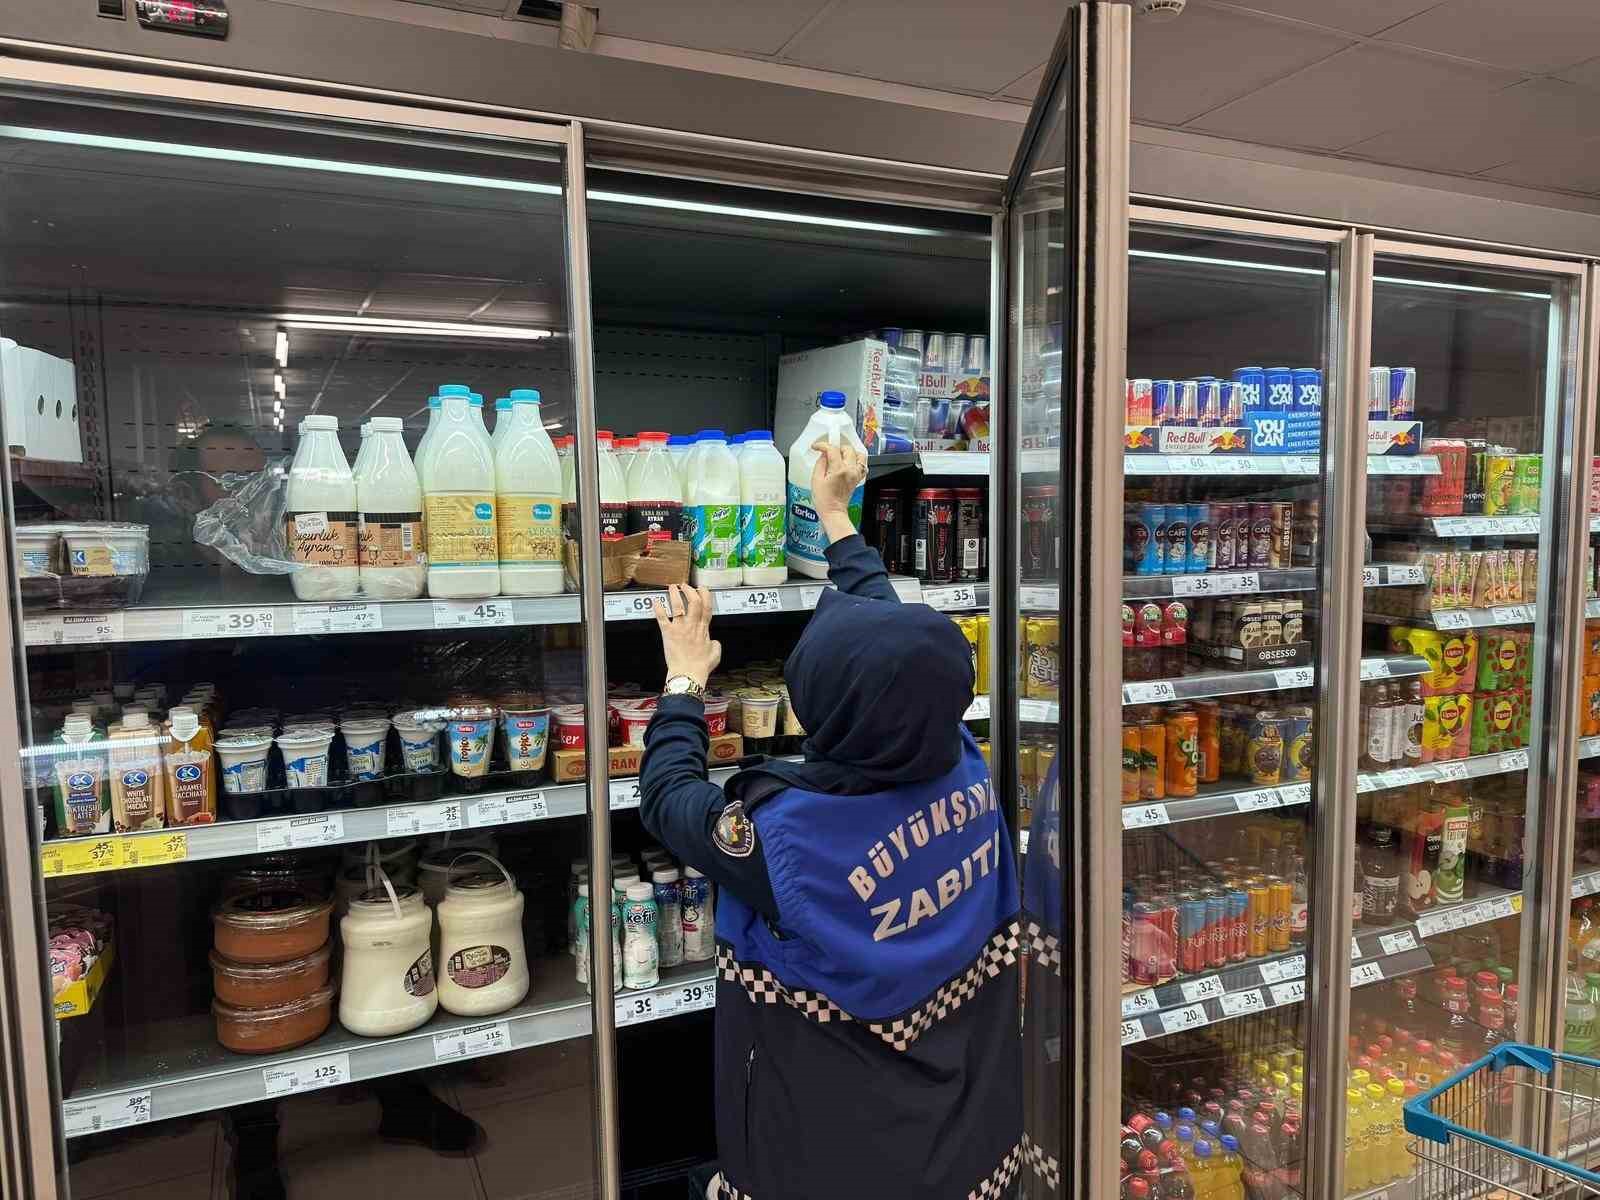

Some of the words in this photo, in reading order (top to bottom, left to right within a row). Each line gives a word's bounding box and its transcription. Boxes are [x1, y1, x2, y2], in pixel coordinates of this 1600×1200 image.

[1254, 419, 1286, 434] YOU
[1167, 431, 1187, 444] Red
[1188, 431, 1206, 444] Bull
[1254, 432, 1285, 447] CAN
[793, 503, 817, 520] Torku
[1195, 578, 1209, 590] 35
[1241, 576, 1253, 587] 35
[953, 588, 968, 601] 35
[474, 604, 497, 617] 45
[96, 625, 110, 635] 95
[1258, 648, 1297, 660] OBSESSO
[1295, 671, 1308, 681] 59
[1153, 684, 1168, 696] 30
[1144, 808, 1159, 820] 45
[627, 909, 656, 924] kefir
[1360, 967, 1374, 977] 11
[1290, 983, 1303, 996] 11
[1134, 993, 1148, 1006] 45
[1244, 993, 1257, 1006] 35
[1183, 1009, 1198, 1023] 20
[485, 1031, 501, 1041] 115
[314, 1065, 337, 1079] 125
[133, 1105, 146, 1113] 75
